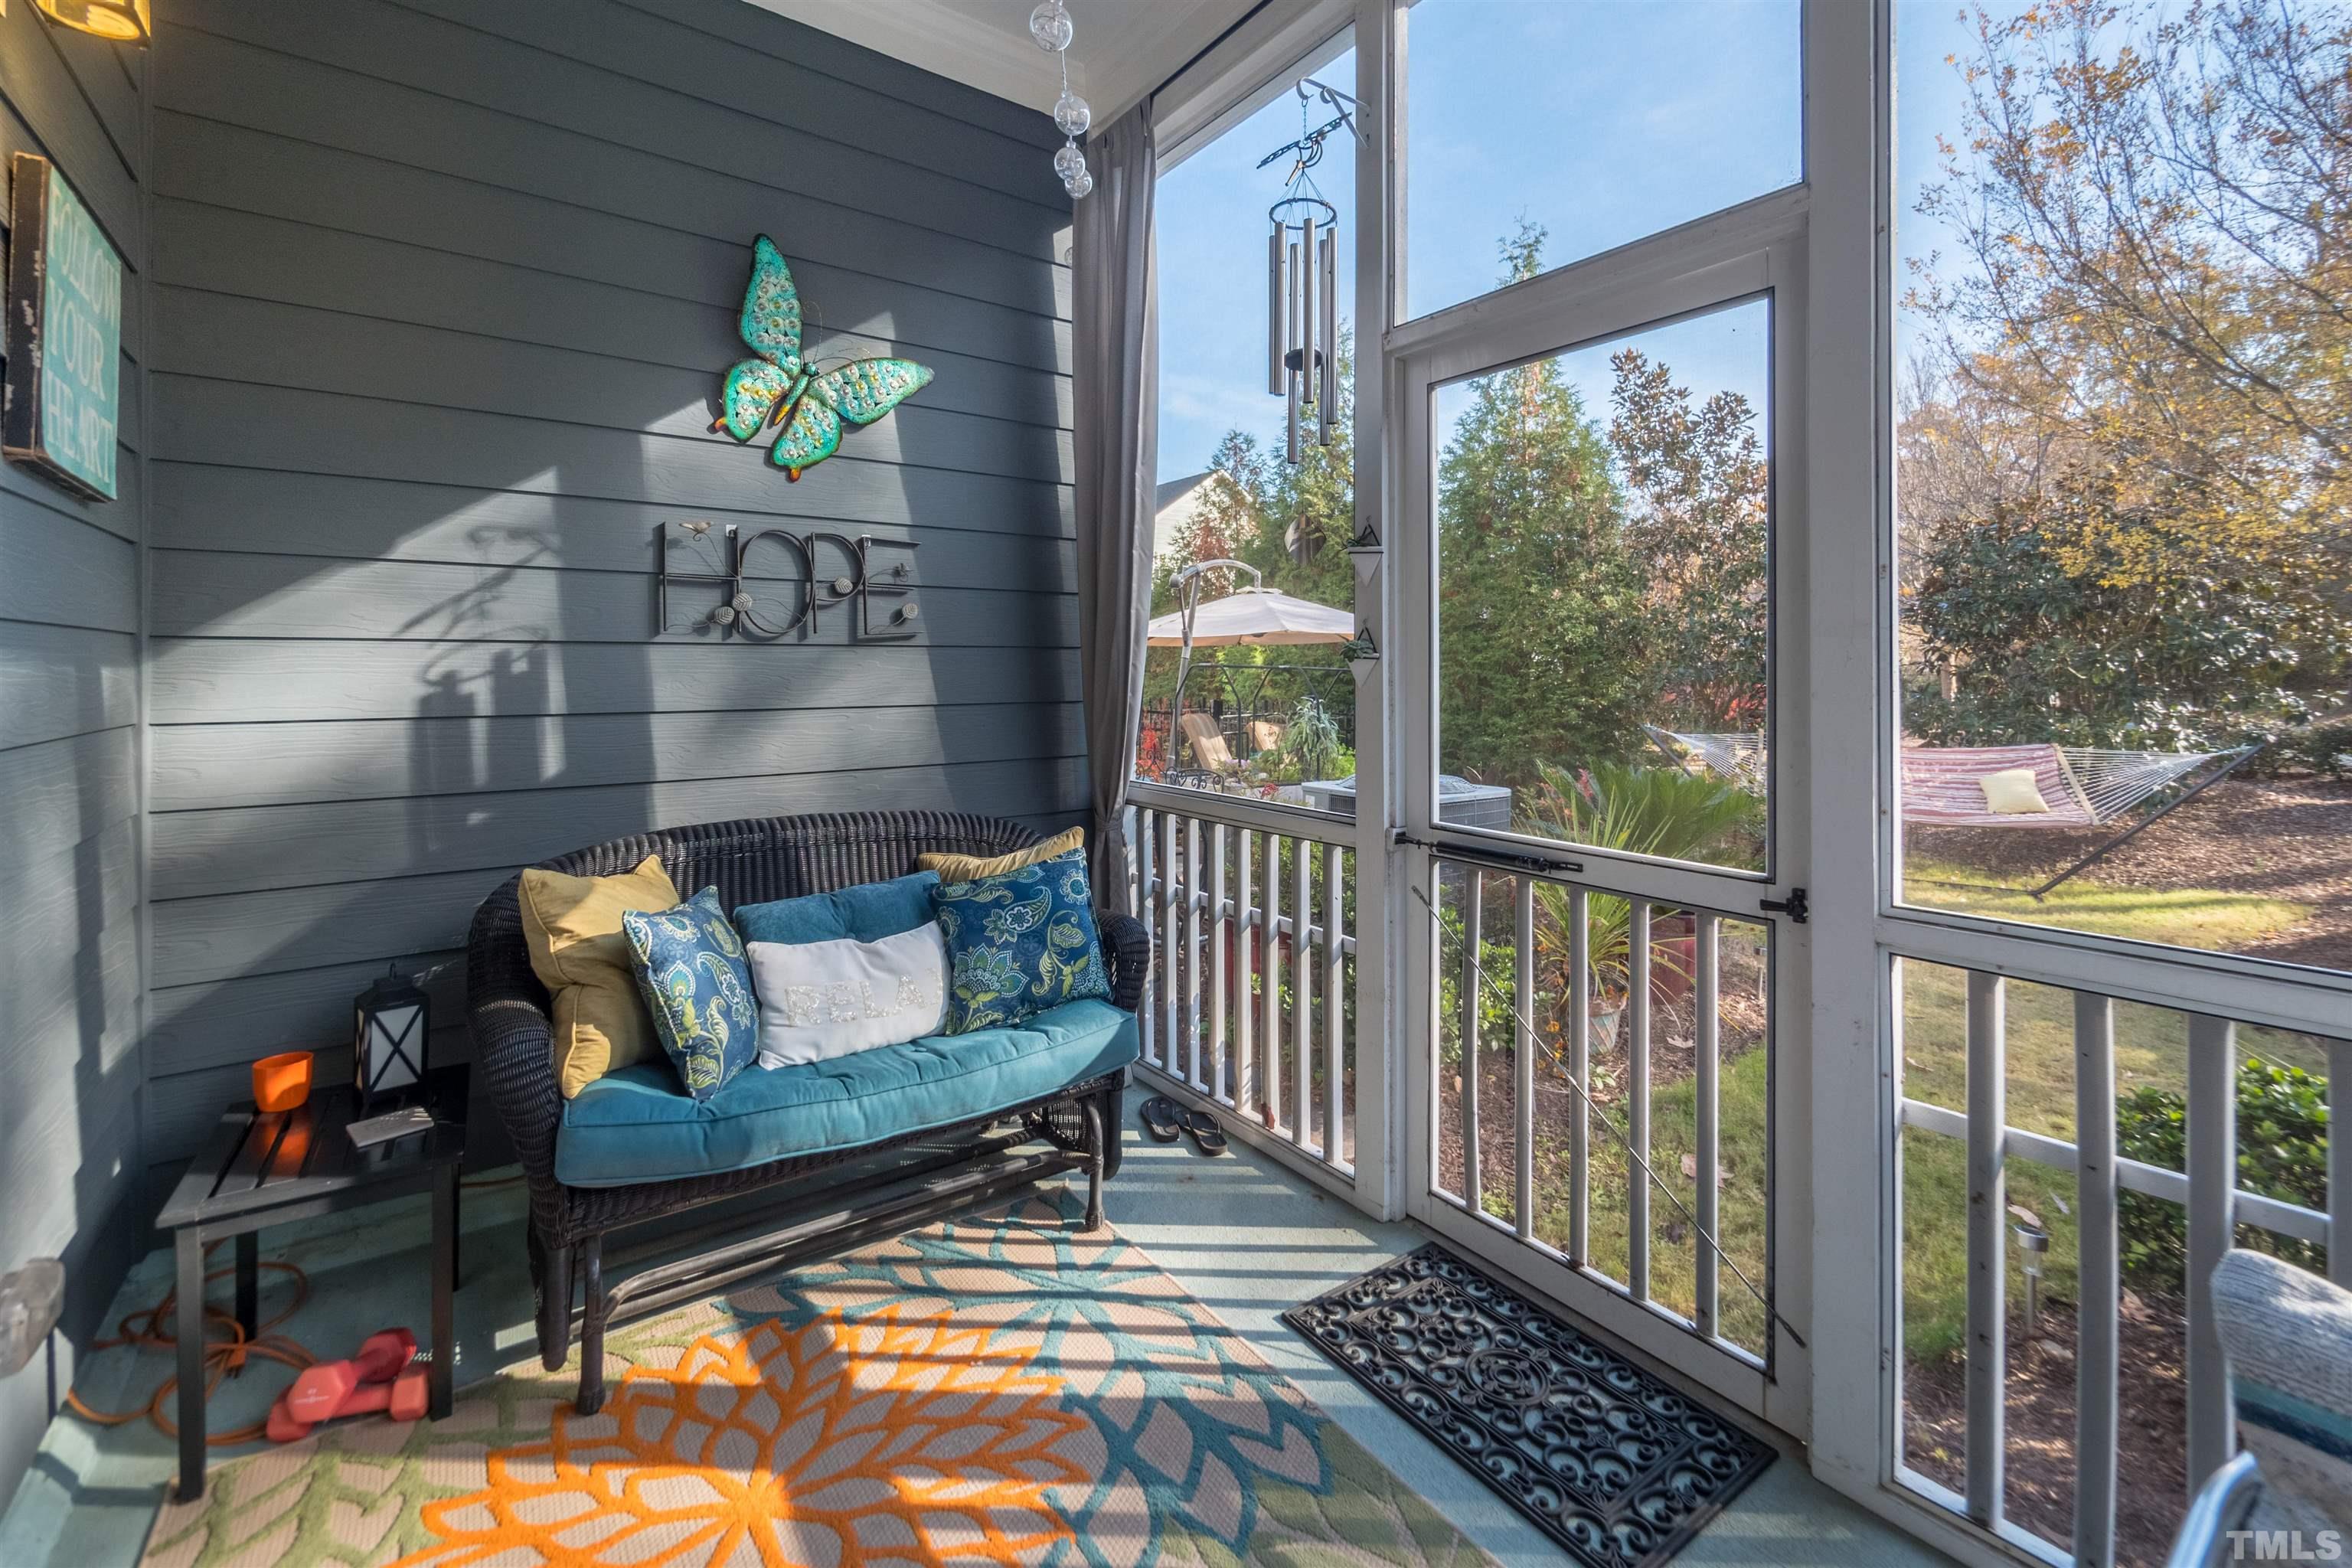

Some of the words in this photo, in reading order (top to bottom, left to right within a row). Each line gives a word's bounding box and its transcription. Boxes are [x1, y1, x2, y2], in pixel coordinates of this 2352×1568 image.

[48, 185, 118, 330] FOLLOW
[48, 276, 106, 402] YOUR
[47, 368, 114, 485] HEART
[662, 521, 925, 635] HOPE
